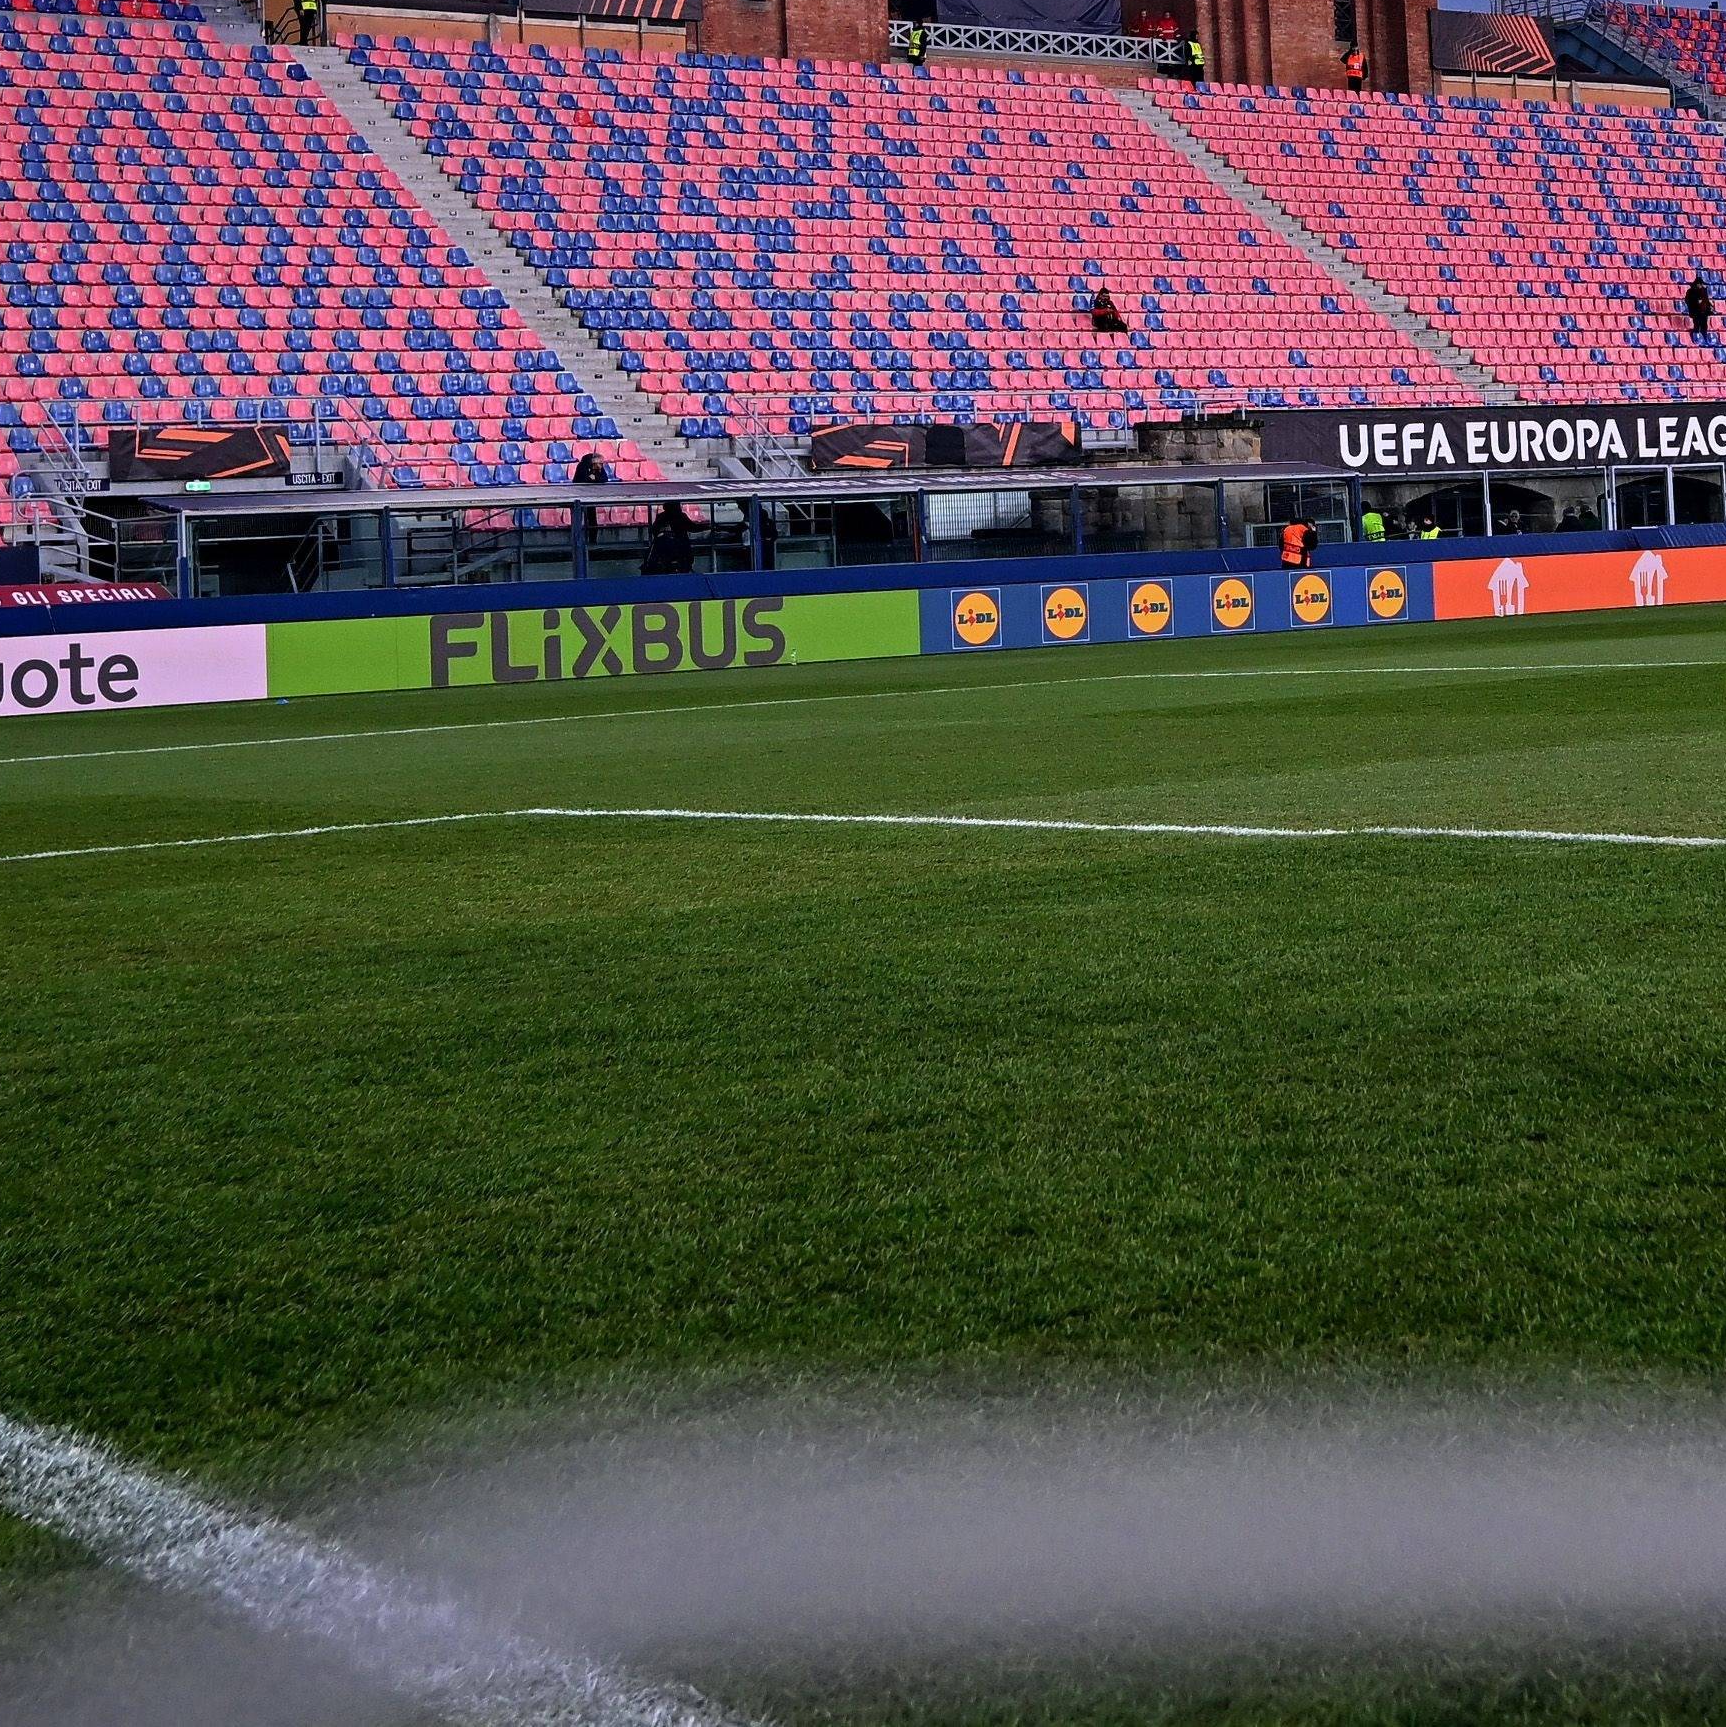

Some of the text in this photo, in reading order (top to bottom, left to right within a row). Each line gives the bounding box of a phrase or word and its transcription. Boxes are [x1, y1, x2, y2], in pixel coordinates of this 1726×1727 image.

[1338, 421, 1455, 468] UEFA
[1466, 418, 1628, 464] EUROPA
[87, 479, 102, 491] EXIT
[292, 473, 336, 485] USCITA EXIT
[12, 591, 50, 606] GLI
[59, 587, 158, 604] SPECIALI
